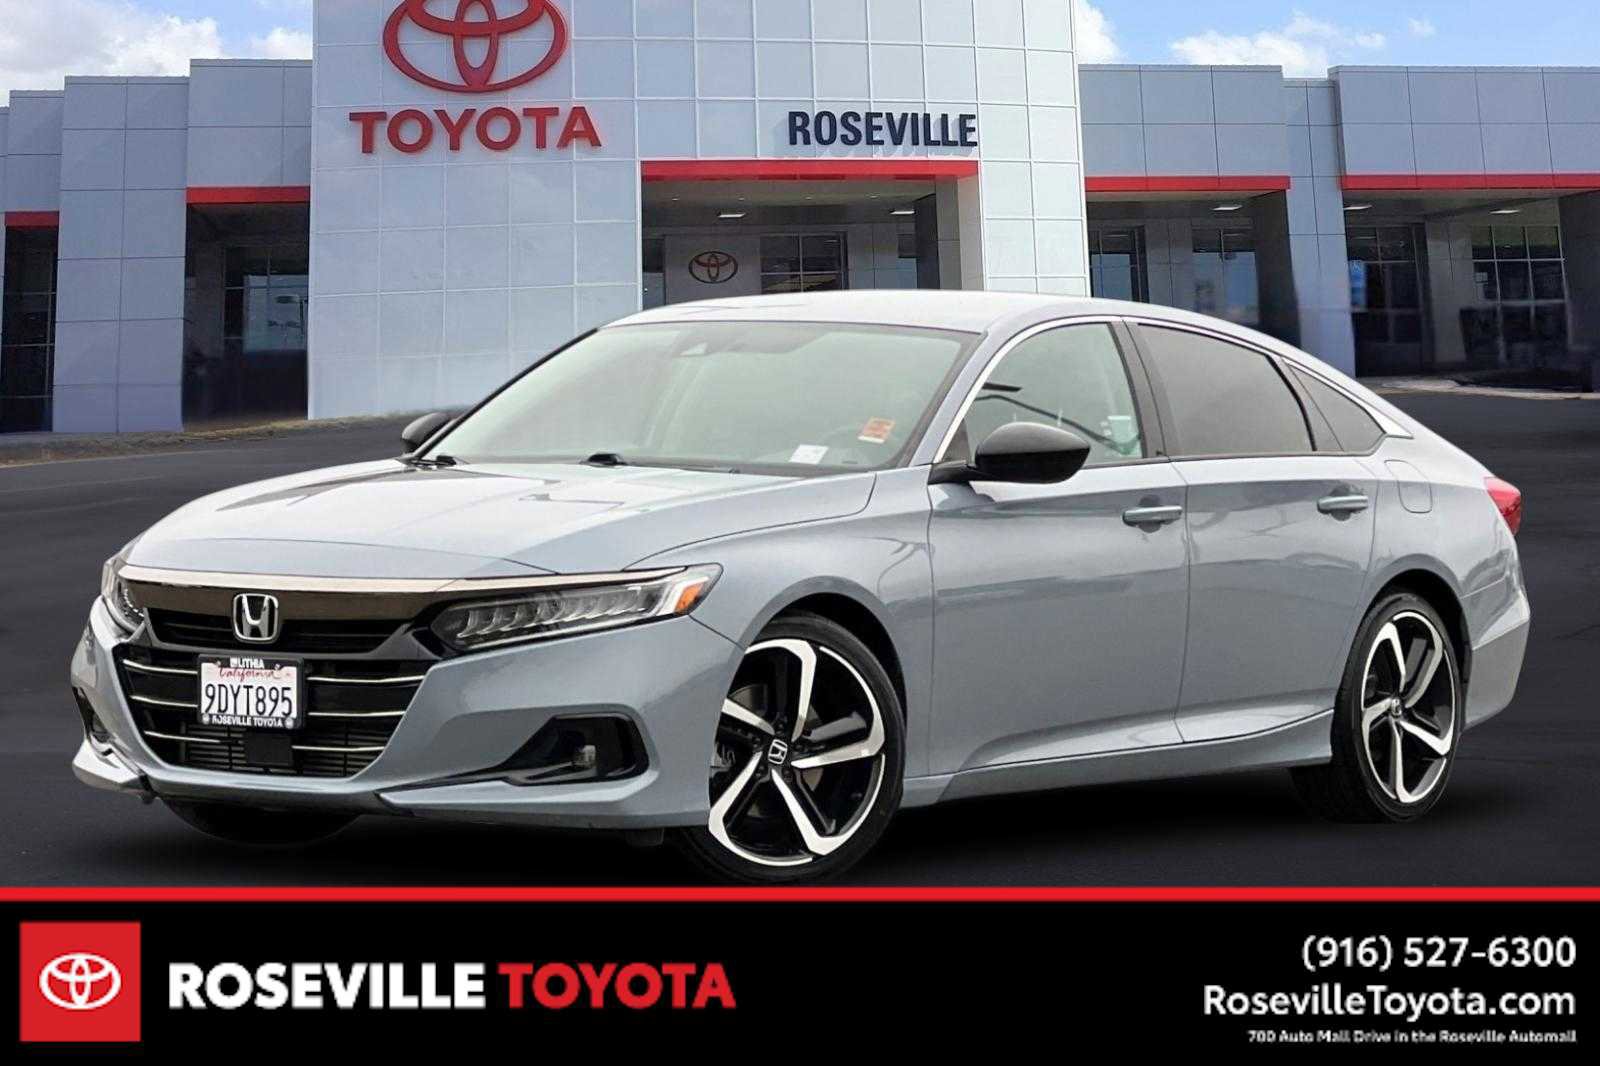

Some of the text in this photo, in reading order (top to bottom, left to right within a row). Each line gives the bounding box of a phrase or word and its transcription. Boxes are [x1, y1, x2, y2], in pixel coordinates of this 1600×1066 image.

[349, 106, 602, 154] TOYOTA
[788, 111, 979, 147] ROSEVILLE
[220, 668, 275, 682] California
[204, 683, 293, 718] 9DYT895
[212, 714, 283, 728] ROSEVILLE TOYOTA
